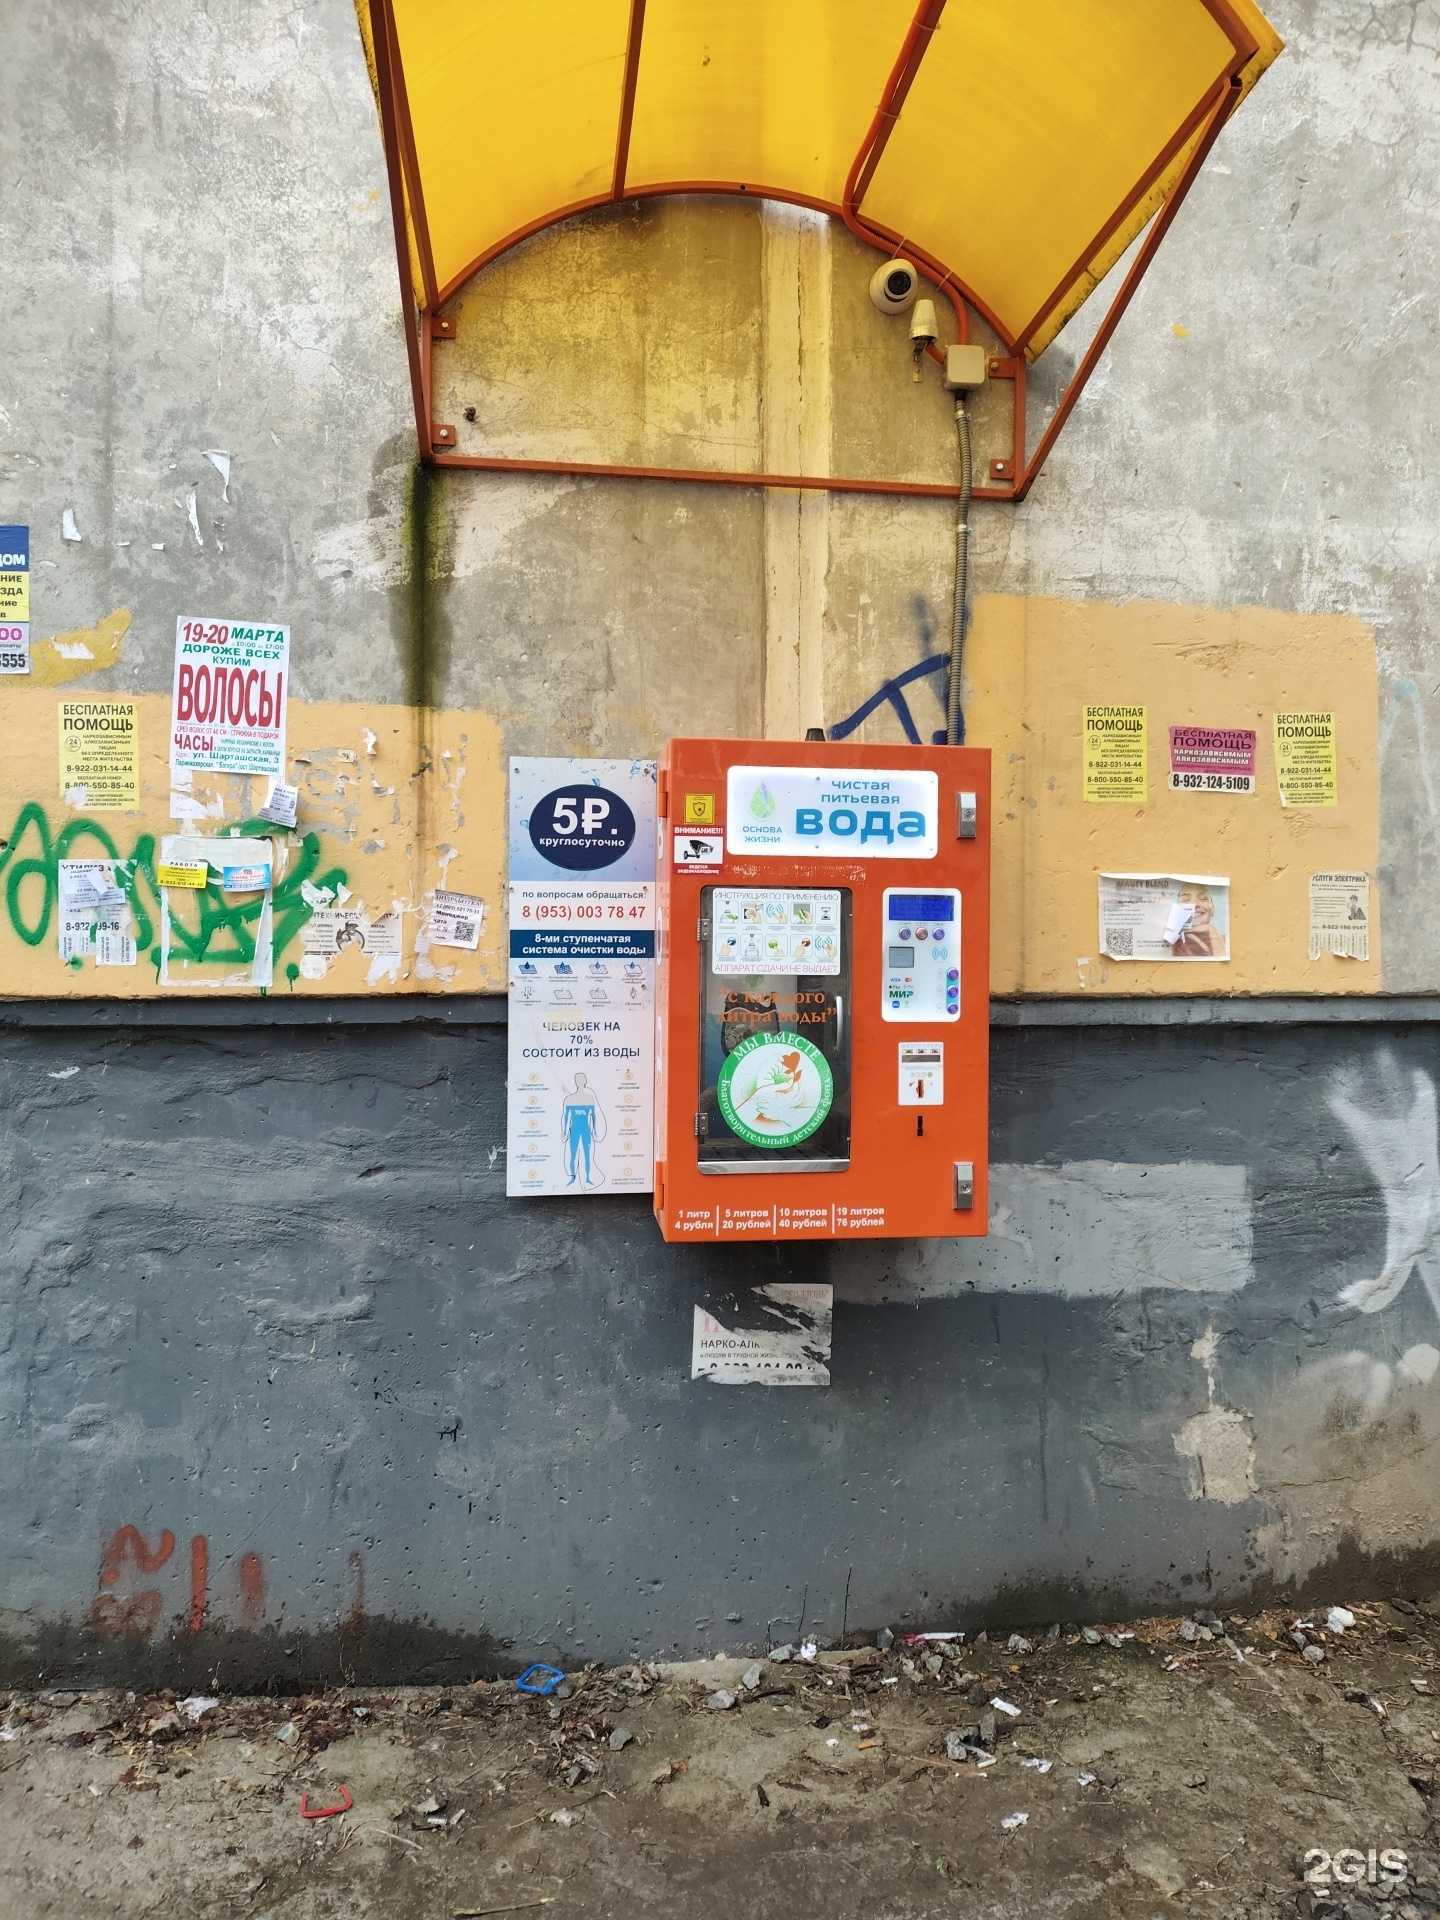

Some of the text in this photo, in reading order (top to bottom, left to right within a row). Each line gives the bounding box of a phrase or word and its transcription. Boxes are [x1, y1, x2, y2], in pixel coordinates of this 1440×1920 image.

[183, 622, 284, 645] 19-20 МАРТА
[182, 643, 280, 660] ДОРОЖЕ ВСЕХ
[212, 656, 251, 667] КУПИМ
[177, 664, 282, 729] ВОЛОСЫ
[64, 704, 133, 716] БЕСПЛАТНАЯ
[1088, 707, 1143, 717] БЕСПЛАТНАЯ
[1278, 714, 1331, 724] БЕСПЛАТНАЯ
[64, 718, 133, 732] ПОМОЩЬ
[1087, 720, 1143, 732] ПОМОЩЬ
[1175, 730, 1252, 740] БЕСПЛАТНАЯ
[1278, 726, 1331, 738] ПОМОЩЬ
[174, 734, 213, 752] ЧАСЫ
[1174, 737, 1252, 750] ПОМОЩЬ
[210, 752, 272, 764] Шарташская,
[831, 780, 890, 792] чистая
[1172, 774, 1250, 790] 8-932-124-5109
[821, 793, 901, 805] питьевая
[742, 826, 783, 834] ОСНОВА
[795, 808, 926, 845] вода
[539, 836, 625, 848] круглосуточно
[744, 835, 781, 844] ЖИЗНИ
[536, 892, 584, 900] вопросам
[714, 892, 767, 901] ИНСТРУКЦИЯ
[783, 892, 839, 901] ПРИМЕНЕНИЮ
[522, 906, 646, 921] 8 (953) 003 78 47
[534, 934, 631, 945] 8-ми ступенчатая
[522, 945, 646, 955] система очистки воды
[715, 964, 837, 973] АППАРАТ СДАЧИ НЕ ВЫДАЕТ
[542, 1022, 621, 1032] ЧЕЛОВЕК НА
[570, 1035, 593, 1044] 70%
[732, 1032, 822, 1060] МЫ ВМЕСТЕ
[522, 1048, 640, 1059] СОСТОИТ ИЗ ВОДЫ
[686, 1210, 710, 1220] литр
[724, 1209, 769, 1219] 5 литров
[779, 1208, 828, 1218] 10 литров
[836, 1207, 885, 1217] 19 литров
[683, 1221, 714, 1231] рубля
[722, 1220, 771, 1230] 20 рублей
[792, 1219, 827, 1229] рублей
[836, 1218, 885, 1228] 76 рублей
